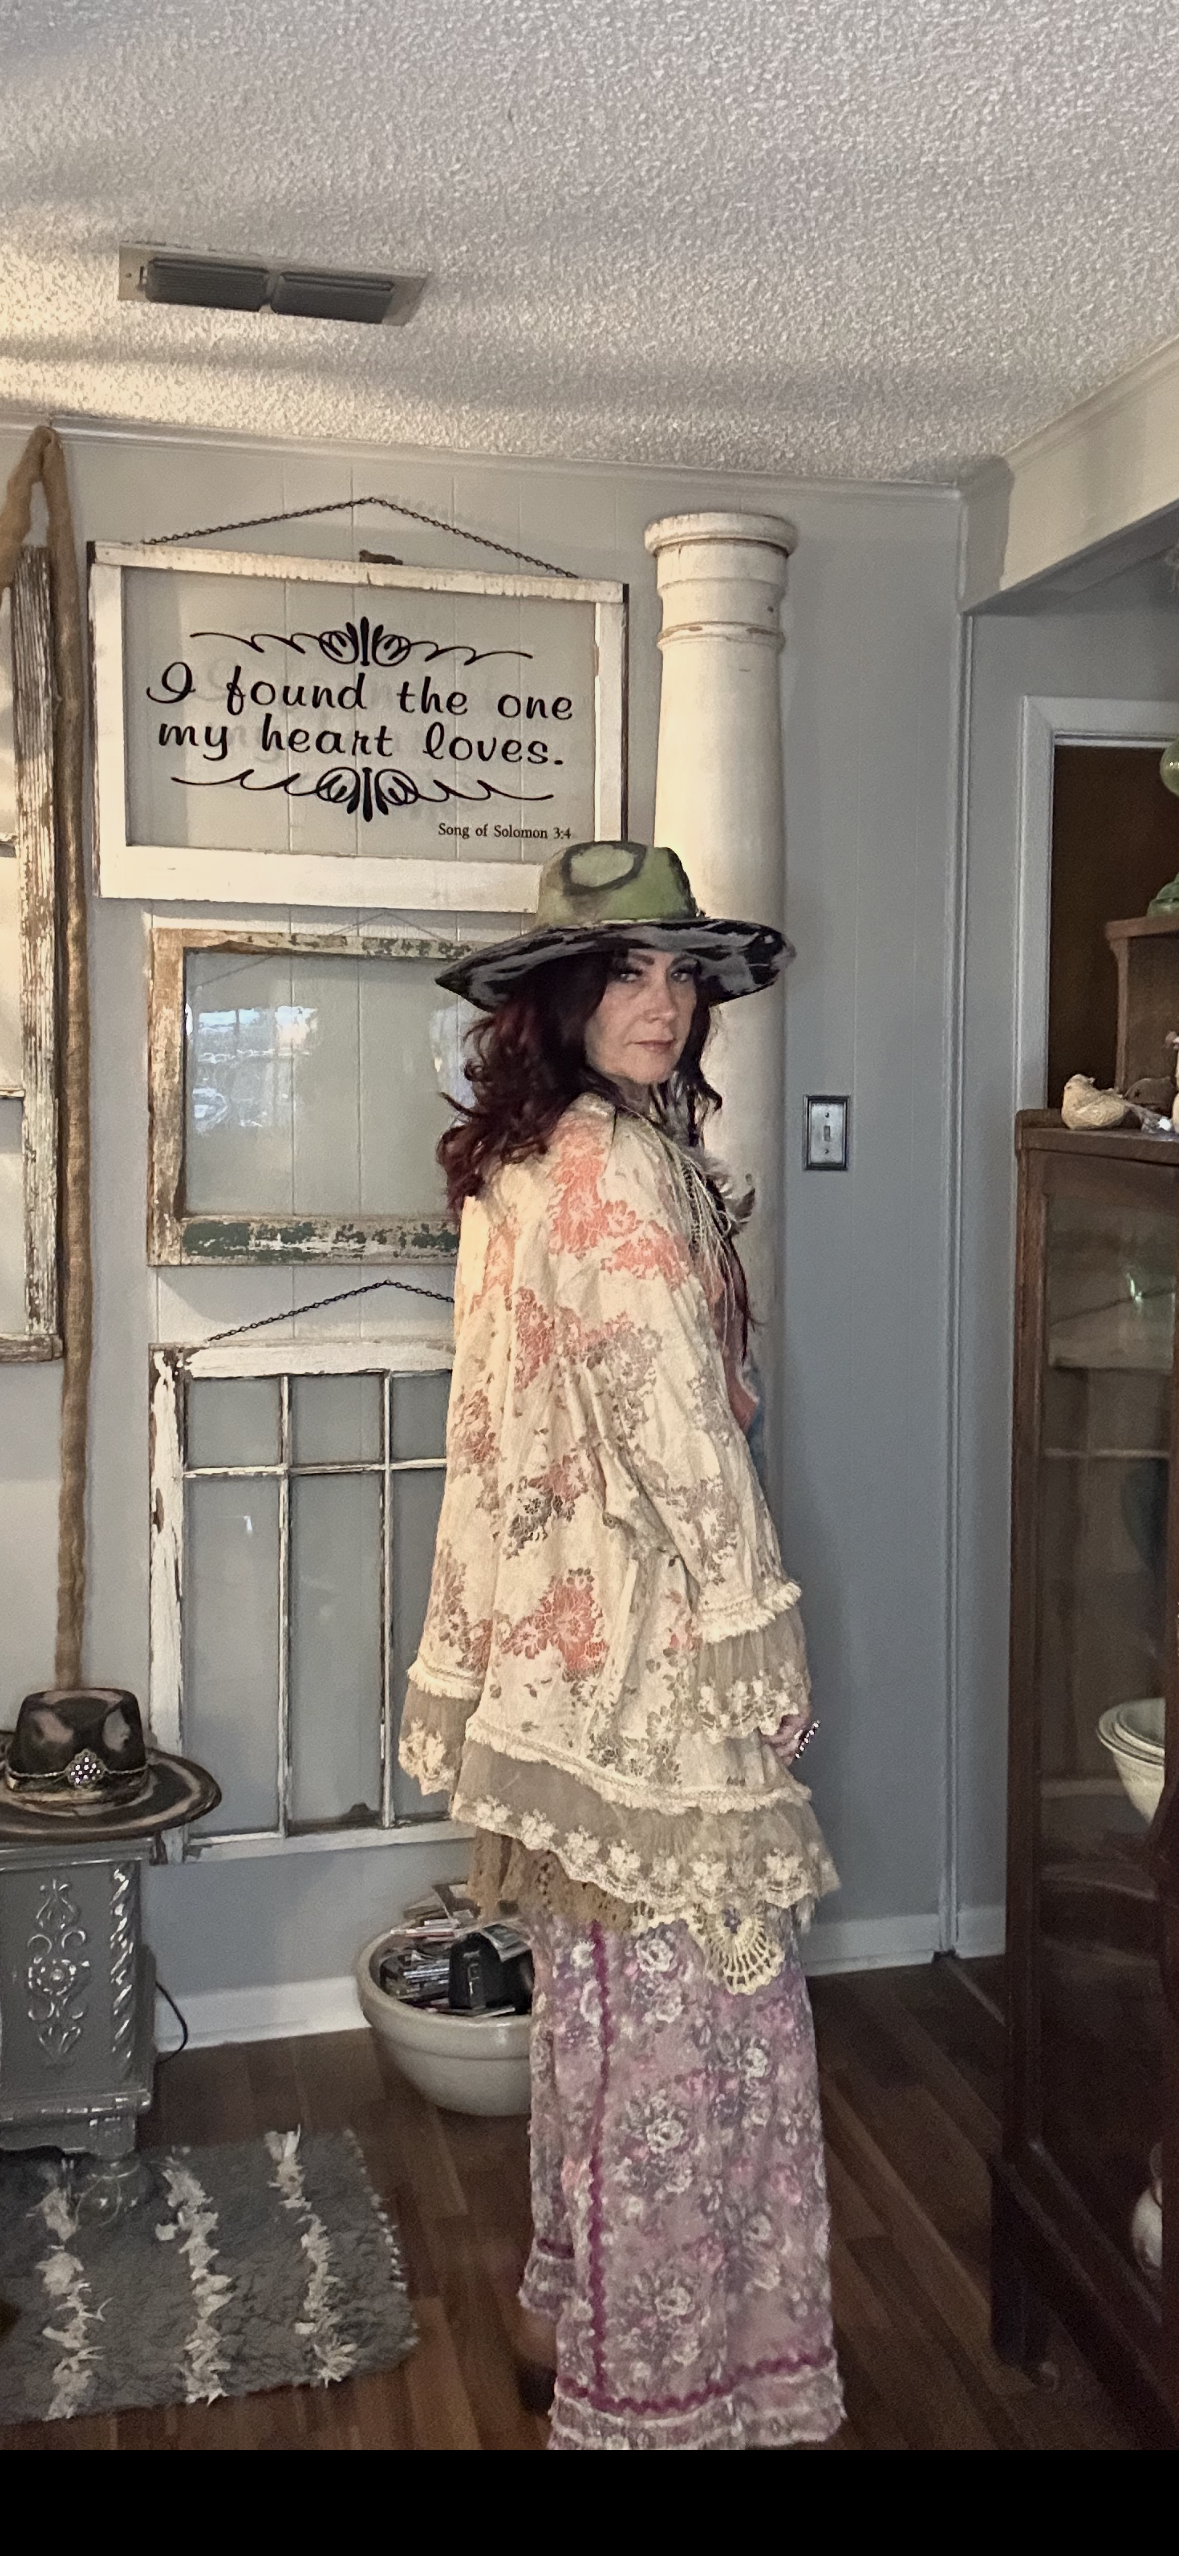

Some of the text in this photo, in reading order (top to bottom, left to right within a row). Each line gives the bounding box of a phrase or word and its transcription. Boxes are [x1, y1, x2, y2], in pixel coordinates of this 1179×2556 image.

[146, 661, 574, 721] I found the one
[158, 712, 565, 766] my heart loves.
[438, 822, 572, 840] Song of Solomon 3:4
